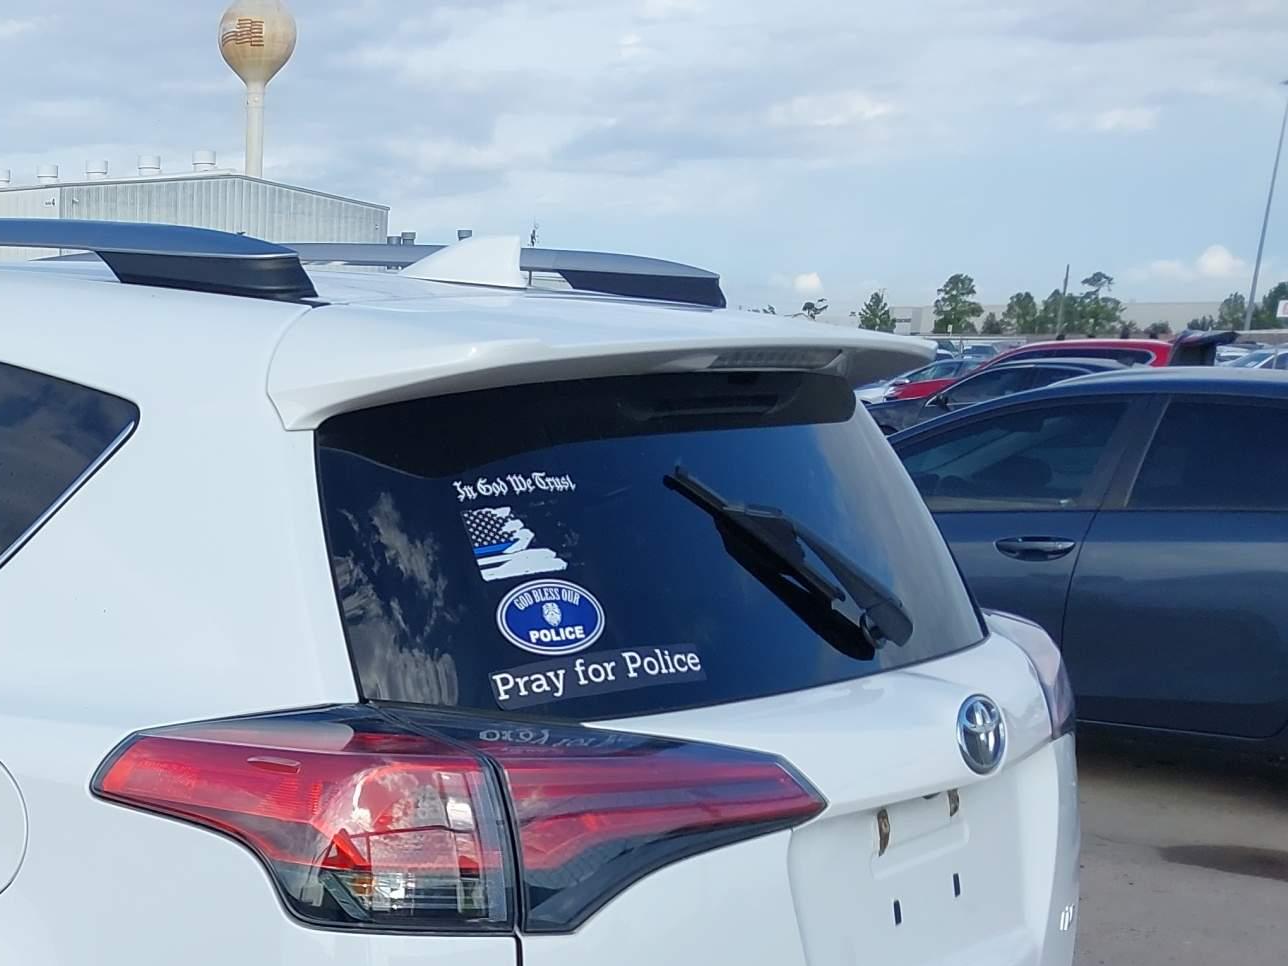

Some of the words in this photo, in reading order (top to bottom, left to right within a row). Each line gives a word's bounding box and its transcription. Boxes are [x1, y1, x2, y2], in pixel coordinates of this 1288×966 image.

[453, 481, 477, 502] In
[477, 478, 508, 496] God
[506, 474, 535, 495] We
[532, 472, 576, 492] Trust
[514, 592, 534, 611] GOD
[532, 588, 561, 603] BLESS
[561, 588, 581, 606] OUR
[529, 625, 585, 643] POLICE
[492, 669, 566, 701] Pray
[574, 658, 616, 685] for
[621, 648, 701, 678] Police
